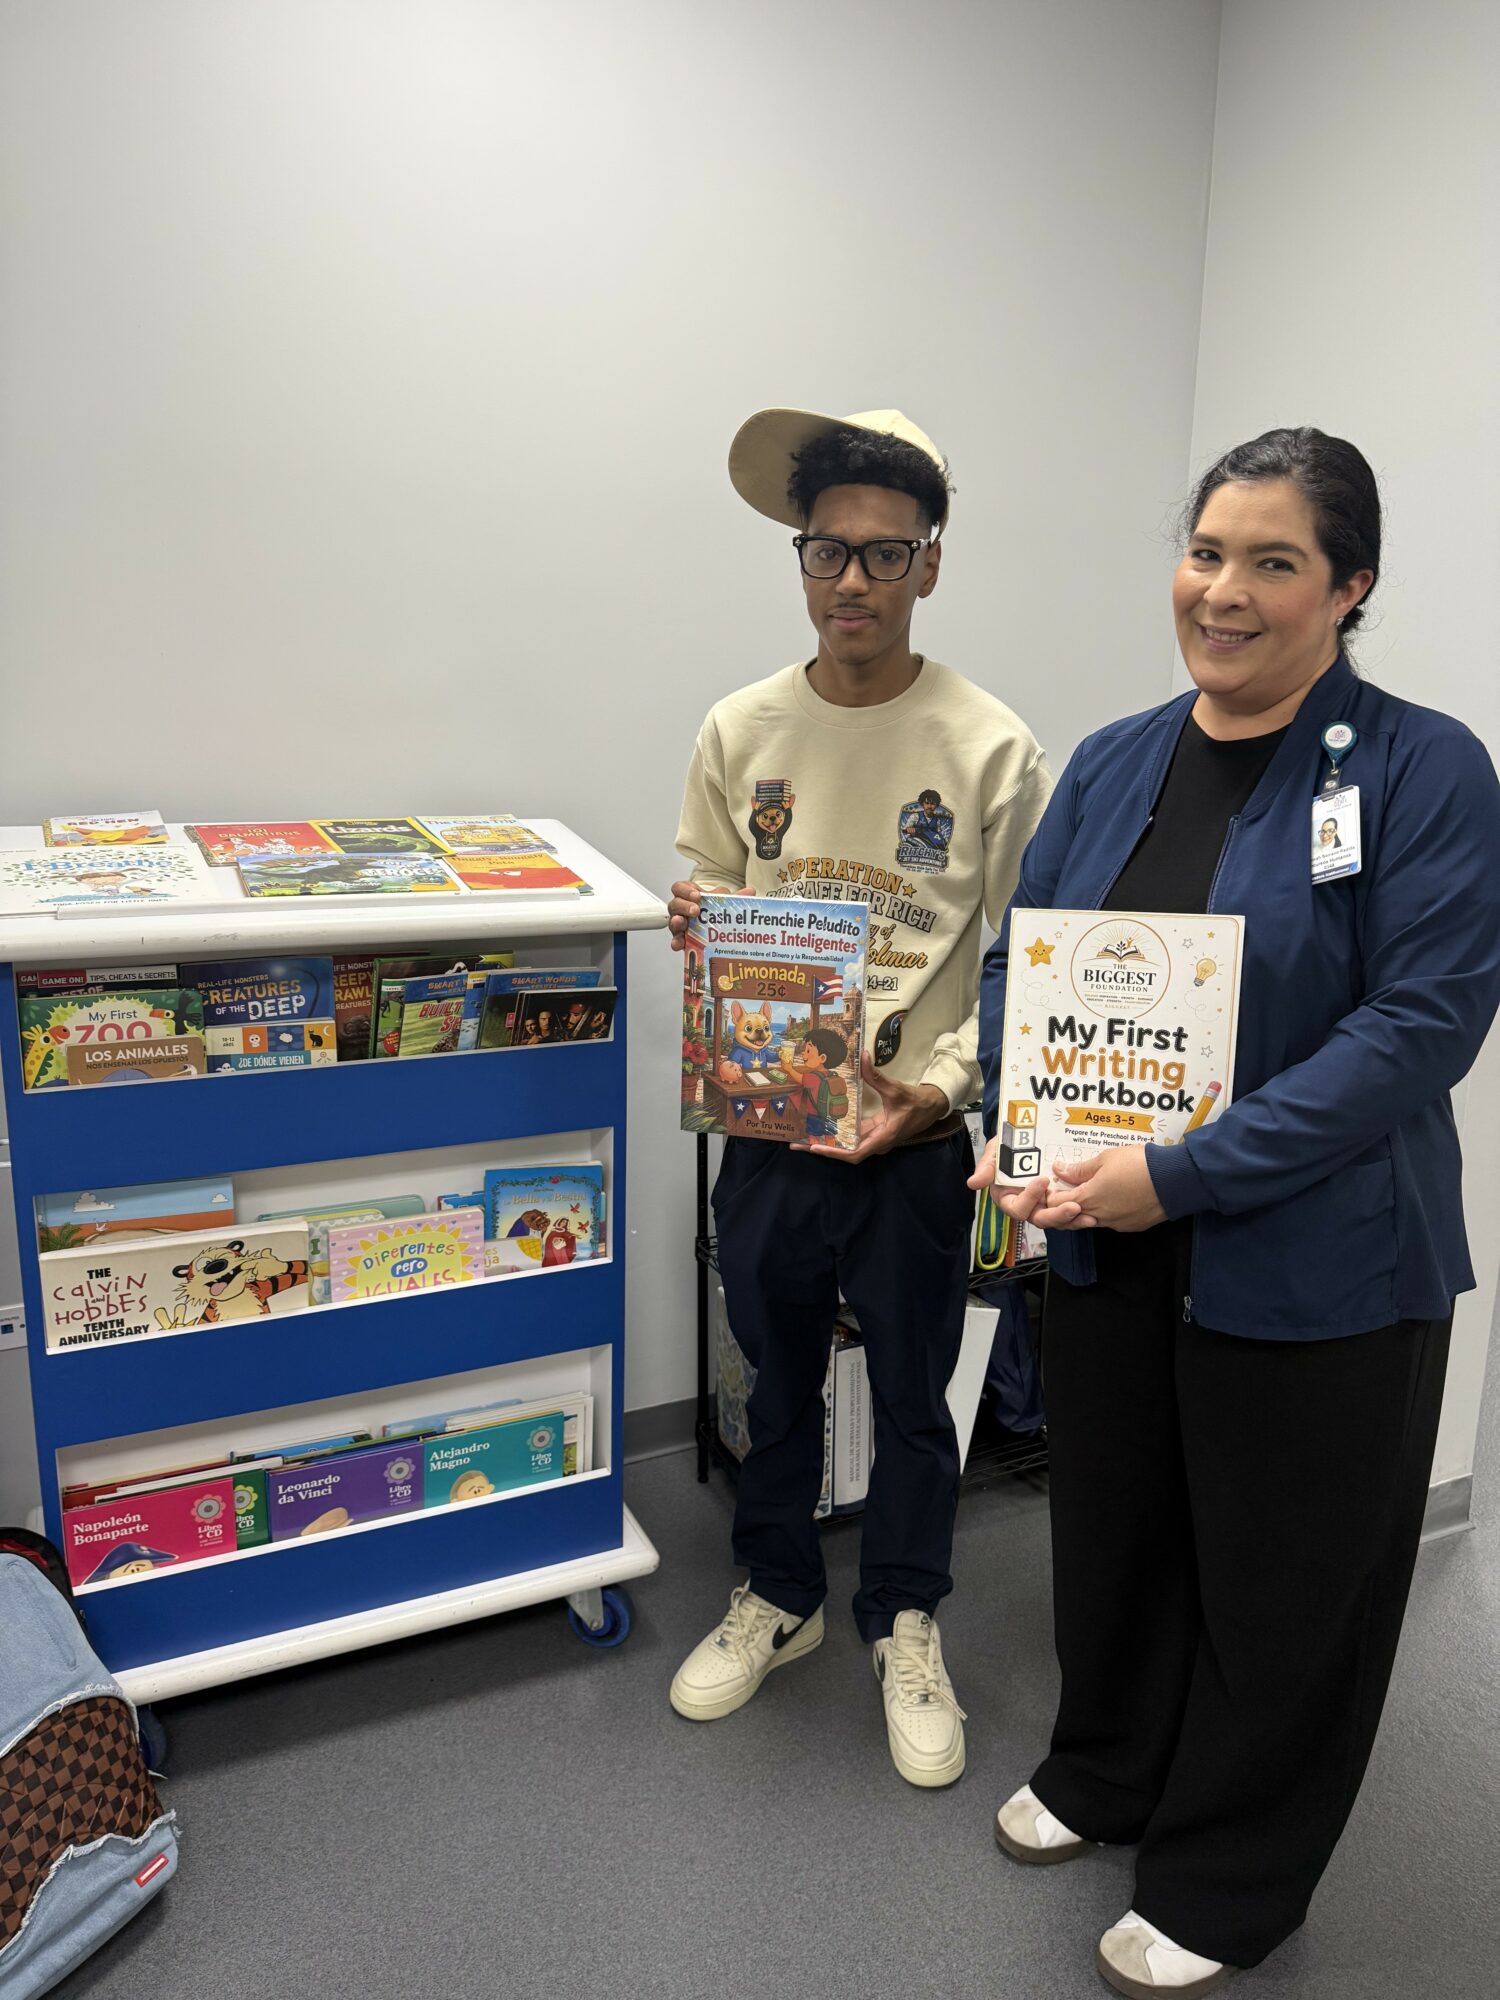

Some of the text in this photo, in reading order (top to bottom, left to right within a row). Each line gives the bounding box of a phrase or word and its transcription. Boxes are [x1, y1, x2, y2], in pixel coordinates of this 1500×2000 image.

[325, 824, 413, 835] Lizards
[900, 846, 946, 862] RITCHY'S
[919, 857, 943, 867] ADVENTURE
[50, 859, 173, 871] Breathe
[787, 856, 904, 896] OPERATION
[793, 881, 843, 901] SAFE
[846, 885, 885, 916] FOR
[887, 895, 937, 933] RICH
[698, 908, 732, 925] Cash
[735, 910, 747, 924] el
[750, 910, 805, 929] Frenchie
[807, 916, 860, 937] Peludito
[880, 922, 896, 940] of
[708, 928, 857, 954] Decisiones Inteligentes
[714, 947, 749, 957] Aprendiendo
[772, 952, 789, 960] Dinero
[801, 953, 844, 963] Responsabilidad
[868, 940, 928, 969] olmar
[42, 976, 84, 985] GAME ON!
[90, 971, 176, 982] TIPS, CHEATS & SECRETS
[234, 974, 269, 984] MONSTERS
[511, 975, 577, 985] SMART WORDS
[728, 962, 807, 985] Limonada
[1082, 968, 1157, 986] BIGGEST
[203, 980, 302, 1006] CREATURES
[428, 980, 460, 990] SMART
[757, 982, 787, 997] 25¢
[1090, 983, 1149, 993] FOUNDATION
[215, 995, 306, 1021] OF THE DEEP
[418, 1001, 463, 1018] BUILT
[88, 1010, 138, 1023] My First
[75, 1021, 152, 1044] ZOO
[1048, 1015, 1189, 1053] My First
[85, 1044, 189, 1063] LOS ANIMALES
[238, 1055, 305, 1068] ¿DE DÓNDE VIENEN
[86, 1062, 102, 1070] NOS
[139, 1058, 152, 1066] LOS
[153, 1055, 189, 1065] OPUESTOS
[1041, 1046, 1186, 1091] Writing
[1029, 1075, 1195, 1114] Workbook
[1020, 1109, 1034, 1124] A
[1085, 1111, 1112, 1125] Ages
[746, 1119, 796, 1132] Por Tru Wells
[1019, 1131, 1030, 1146] B
[1065, 1127, 1155, 1143] Prepare for Preschool & Pre-K
[1073, 1136, 1120, 1147] with Easy Home
[1019, 1155, 1033, 1172] C
[511, 1194, 541, 1205] Bella
[362, 1241, 456, 1271] Diferentes
[87, 1267, 112, 1280] THE
[394, 1259, 425, 1275] pero
[83, 1318, 125, 1333] TENTH
[58, 1323, 150, 1347] ANNIVERSARY
[429, 1441, 491, 1463] Alejandro
[531, 1452, 553, 1462] Libro
[429, 1456, 471, 1473] Magno
[537, 1457, 552, 1466] CD
[277, 1474, 342, 1495] Leonardo
[388, 1483, 412, 1494] Libro
[396, 1487, 412, 1498] CD
[277, 1485, 333, 1505] da Vinci
[73, 1512, 142, 1535] Napoleón
[197, 1523, 224, 1535] Libro
[238, 1517, 255, 1529] CD
[73, 1522, 150, 1547] Bonaparte
[205, 1528, 224, 1540] CD
